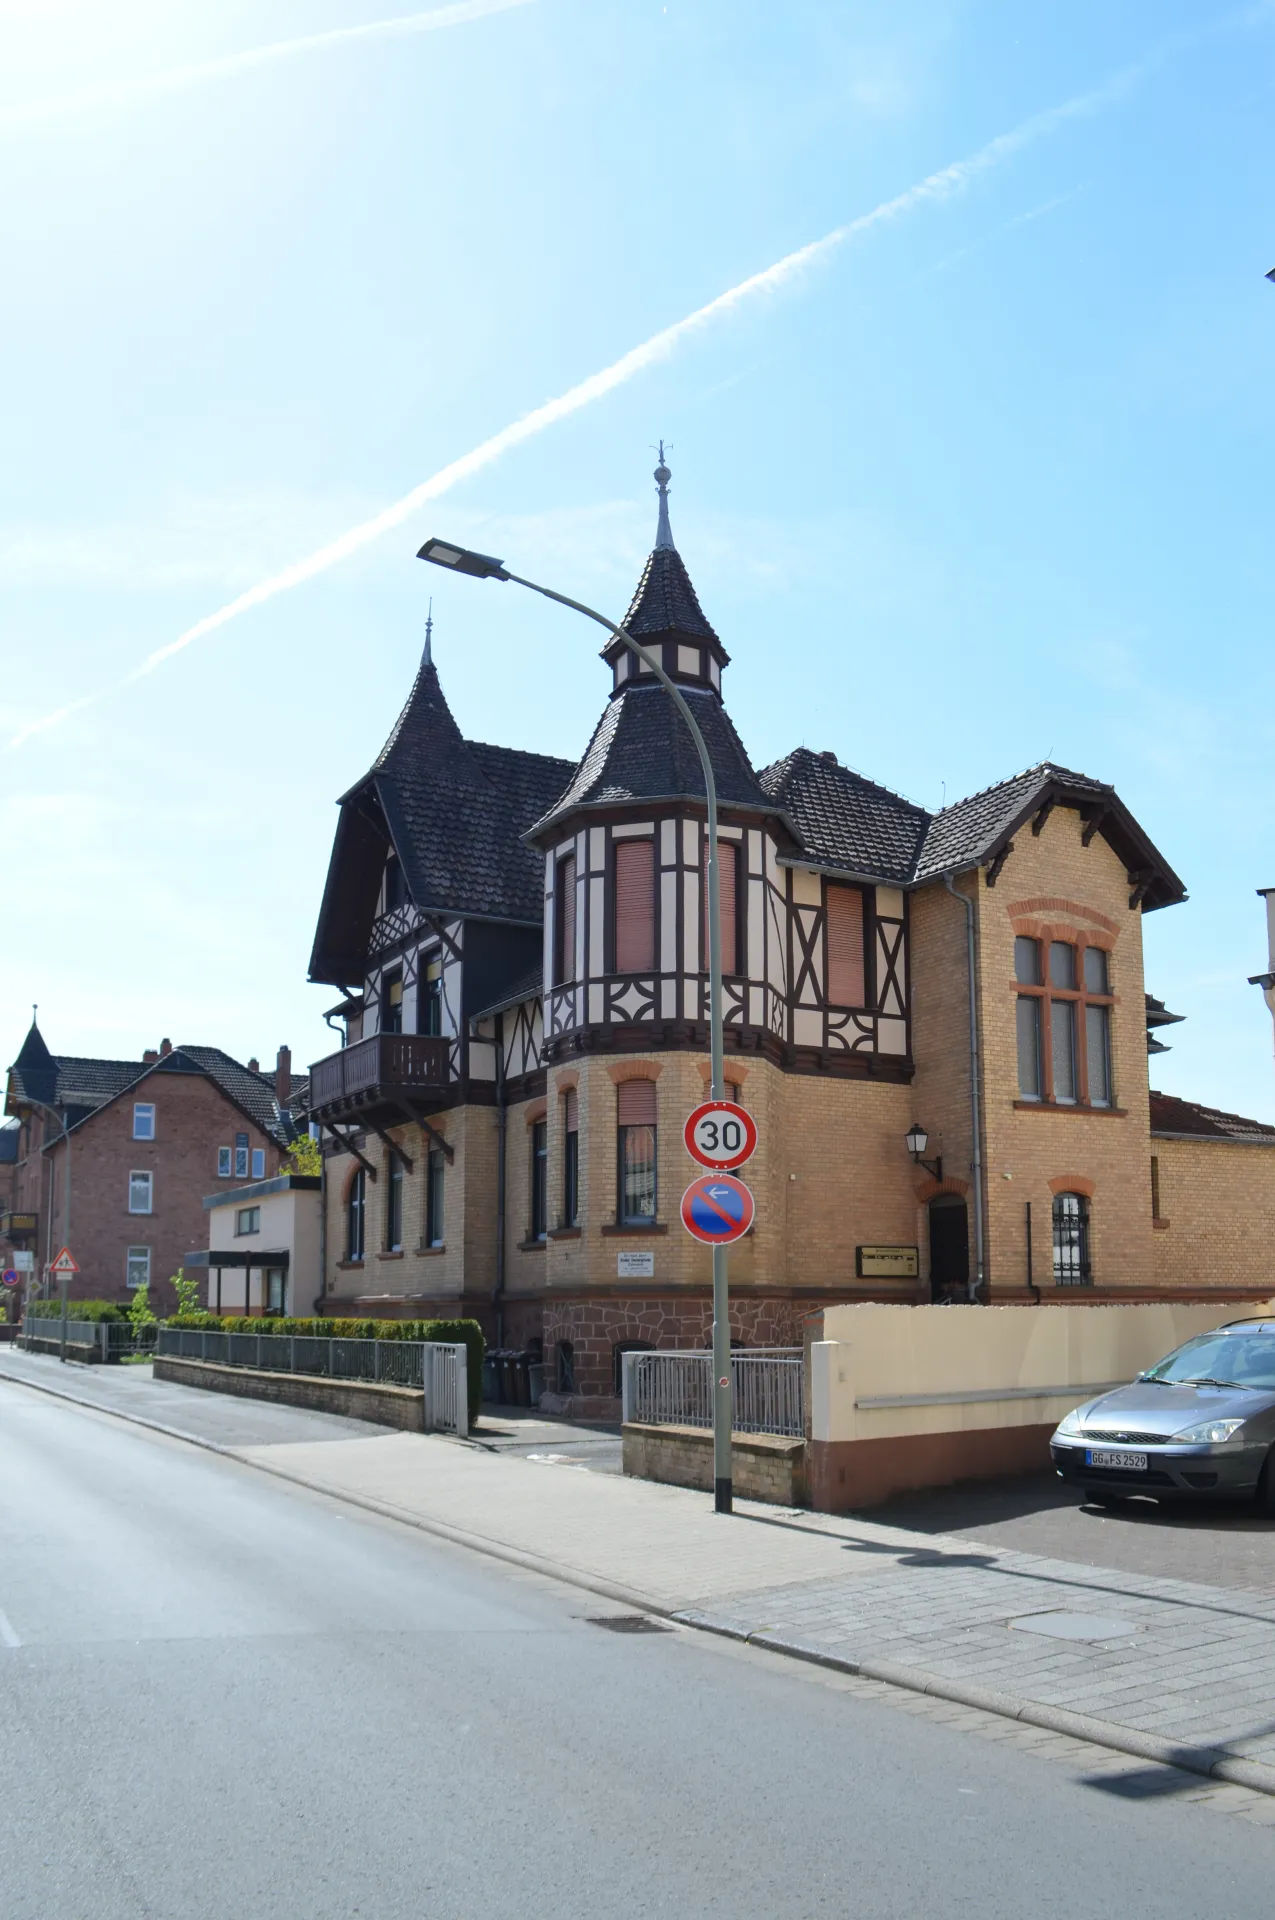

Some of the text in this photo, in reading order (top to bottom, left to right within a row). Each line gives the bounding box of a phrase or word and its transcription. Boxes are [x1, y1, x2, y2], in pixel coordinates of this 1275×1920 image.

[700, 1120, 741, 1151] 30
[1092, 1453, 1146, 1467] GG FS 2529
